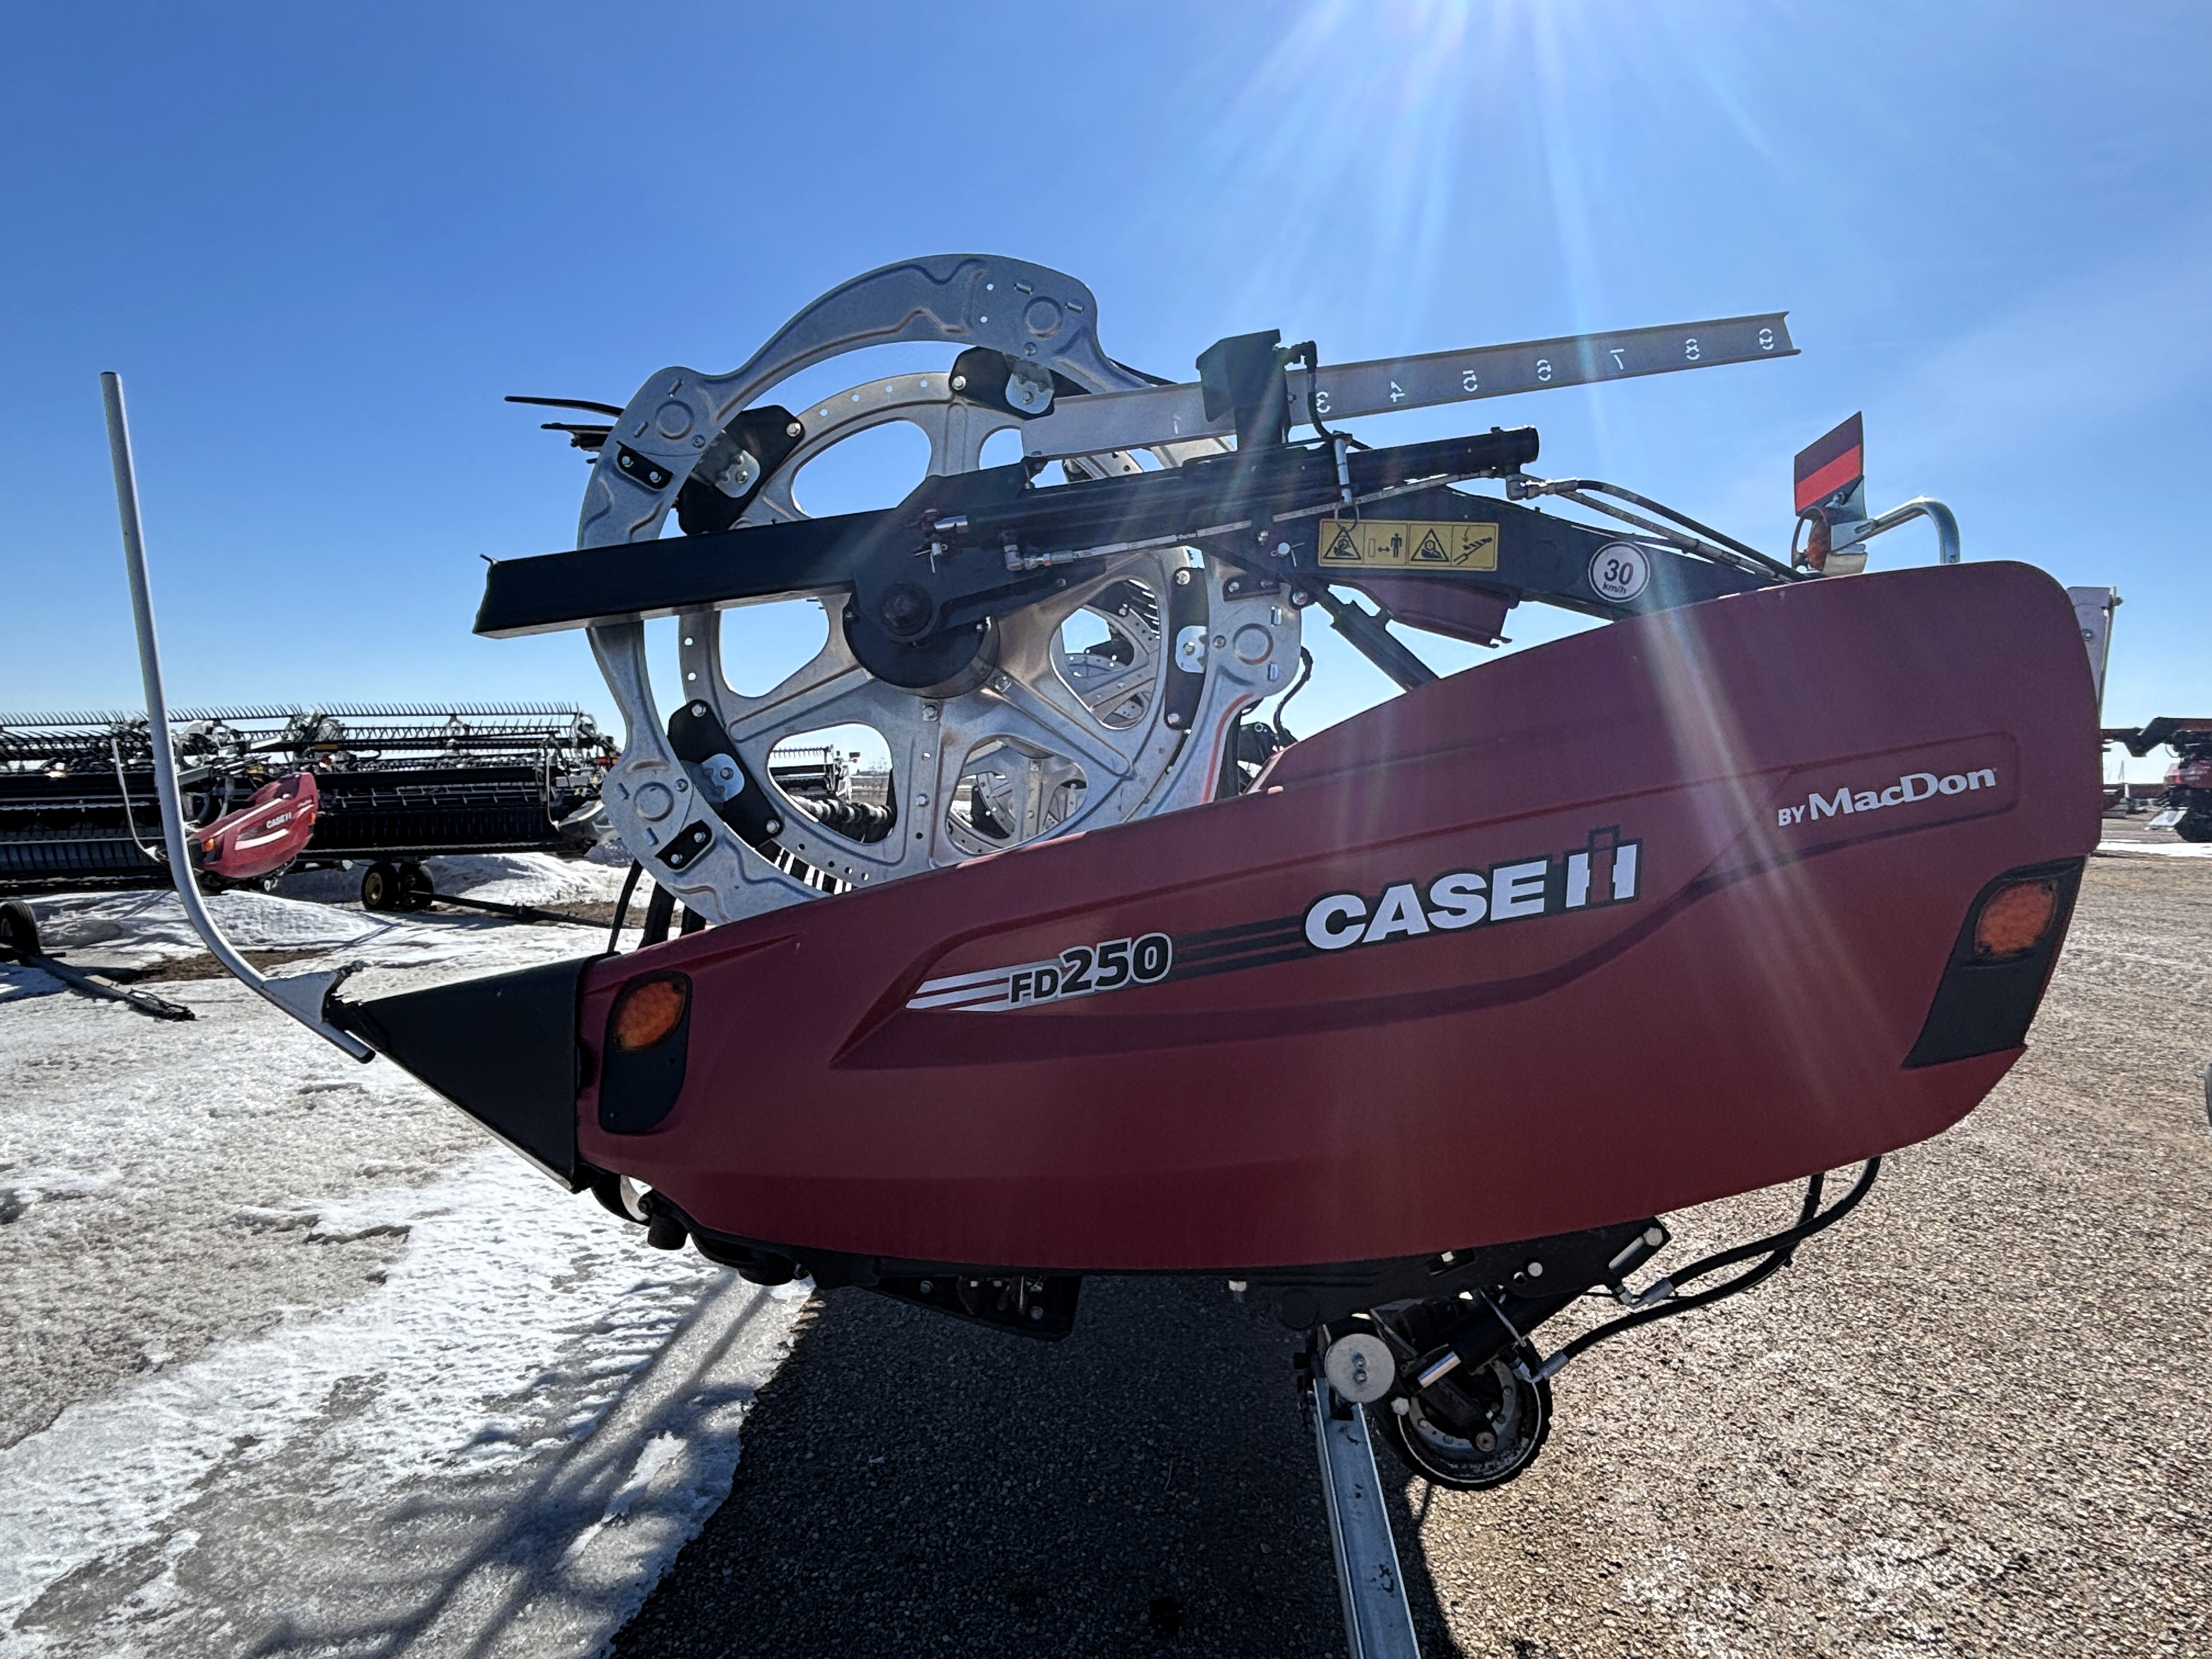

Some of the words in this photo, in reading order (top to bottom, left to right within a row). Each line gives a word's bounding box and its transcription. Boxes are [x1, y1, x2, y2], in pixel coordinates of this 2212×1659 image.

[1602, 582, 1627, 595] km/h
[1604, 558, 1634, 585] 30
[1778, 804, 1806, 827] BY
[1808, 768, 1998, 821] MacDon
[1304, 858, 1549, 951] CASE
